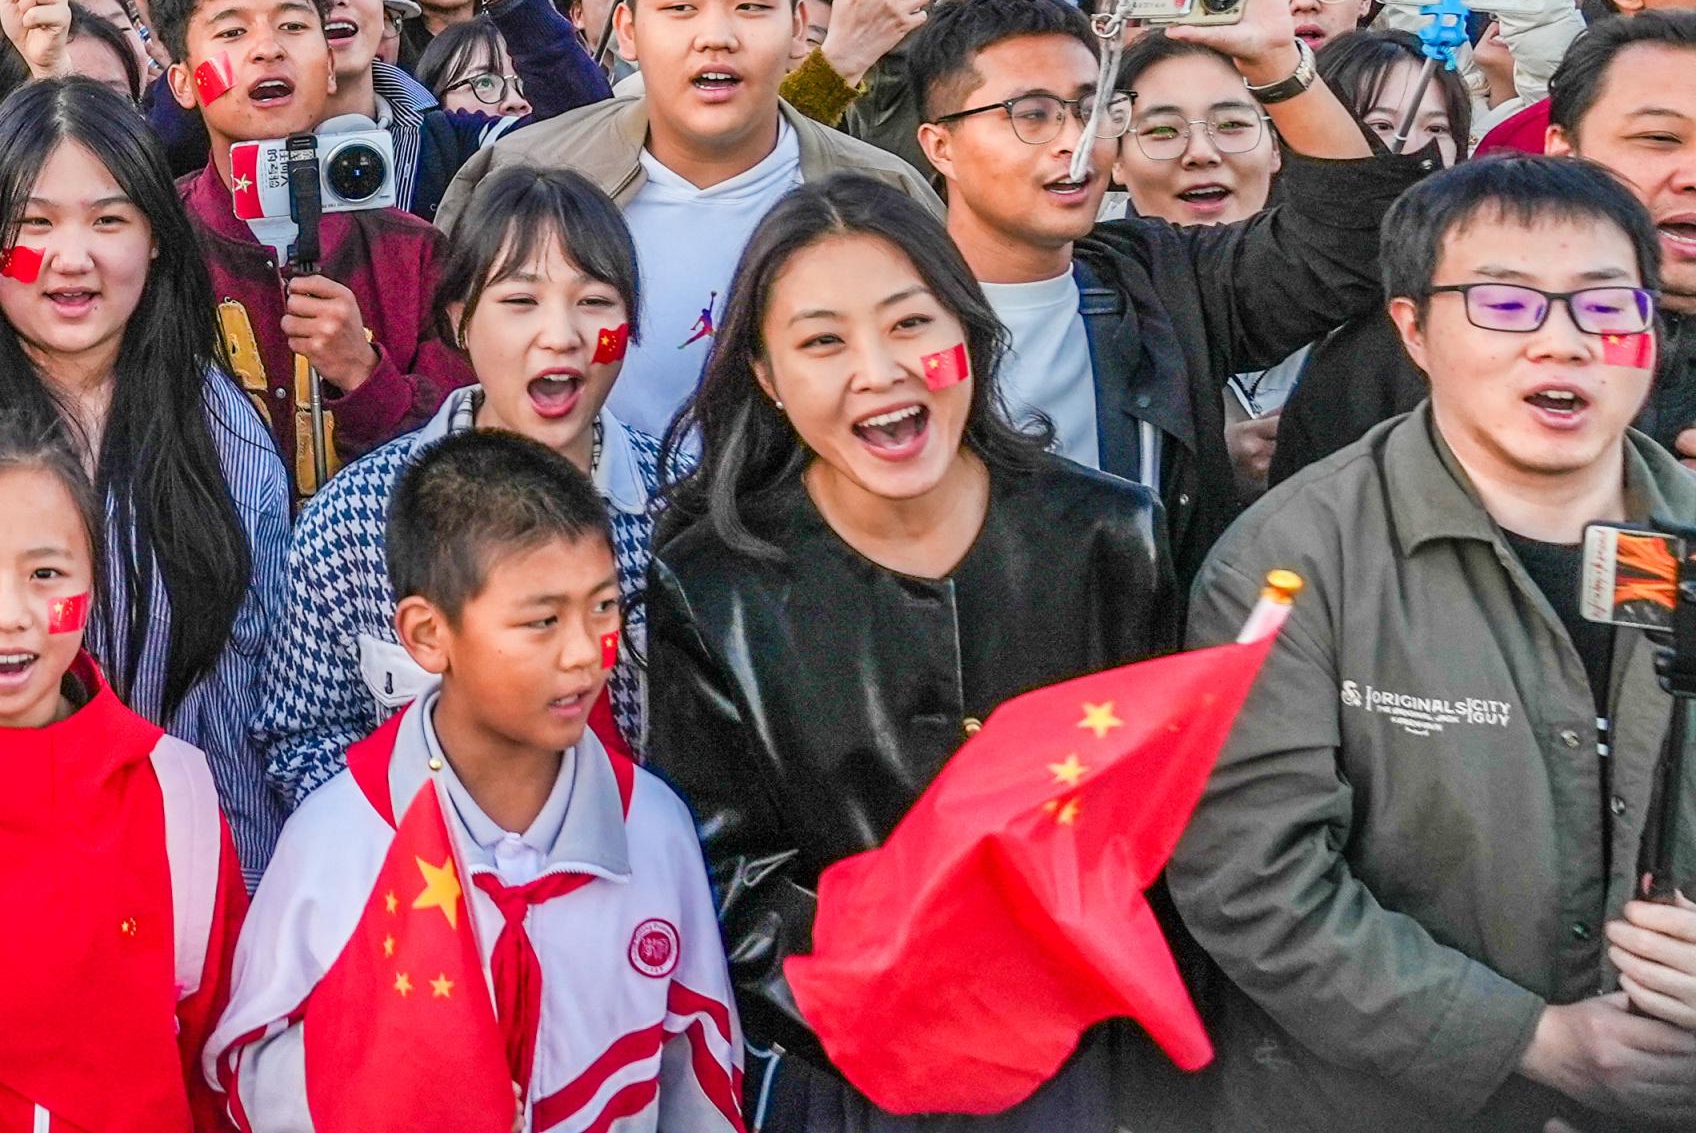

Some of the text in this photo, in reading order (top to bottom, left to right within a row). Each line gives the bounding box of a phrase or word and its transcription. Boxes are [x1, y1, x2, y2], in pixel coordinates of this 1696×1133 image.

[1371, 690, 1467, 716] ORIGINALS
[1471, 698, 1512, 715] CITY
[1472, 712, 1511, 728] GUY
